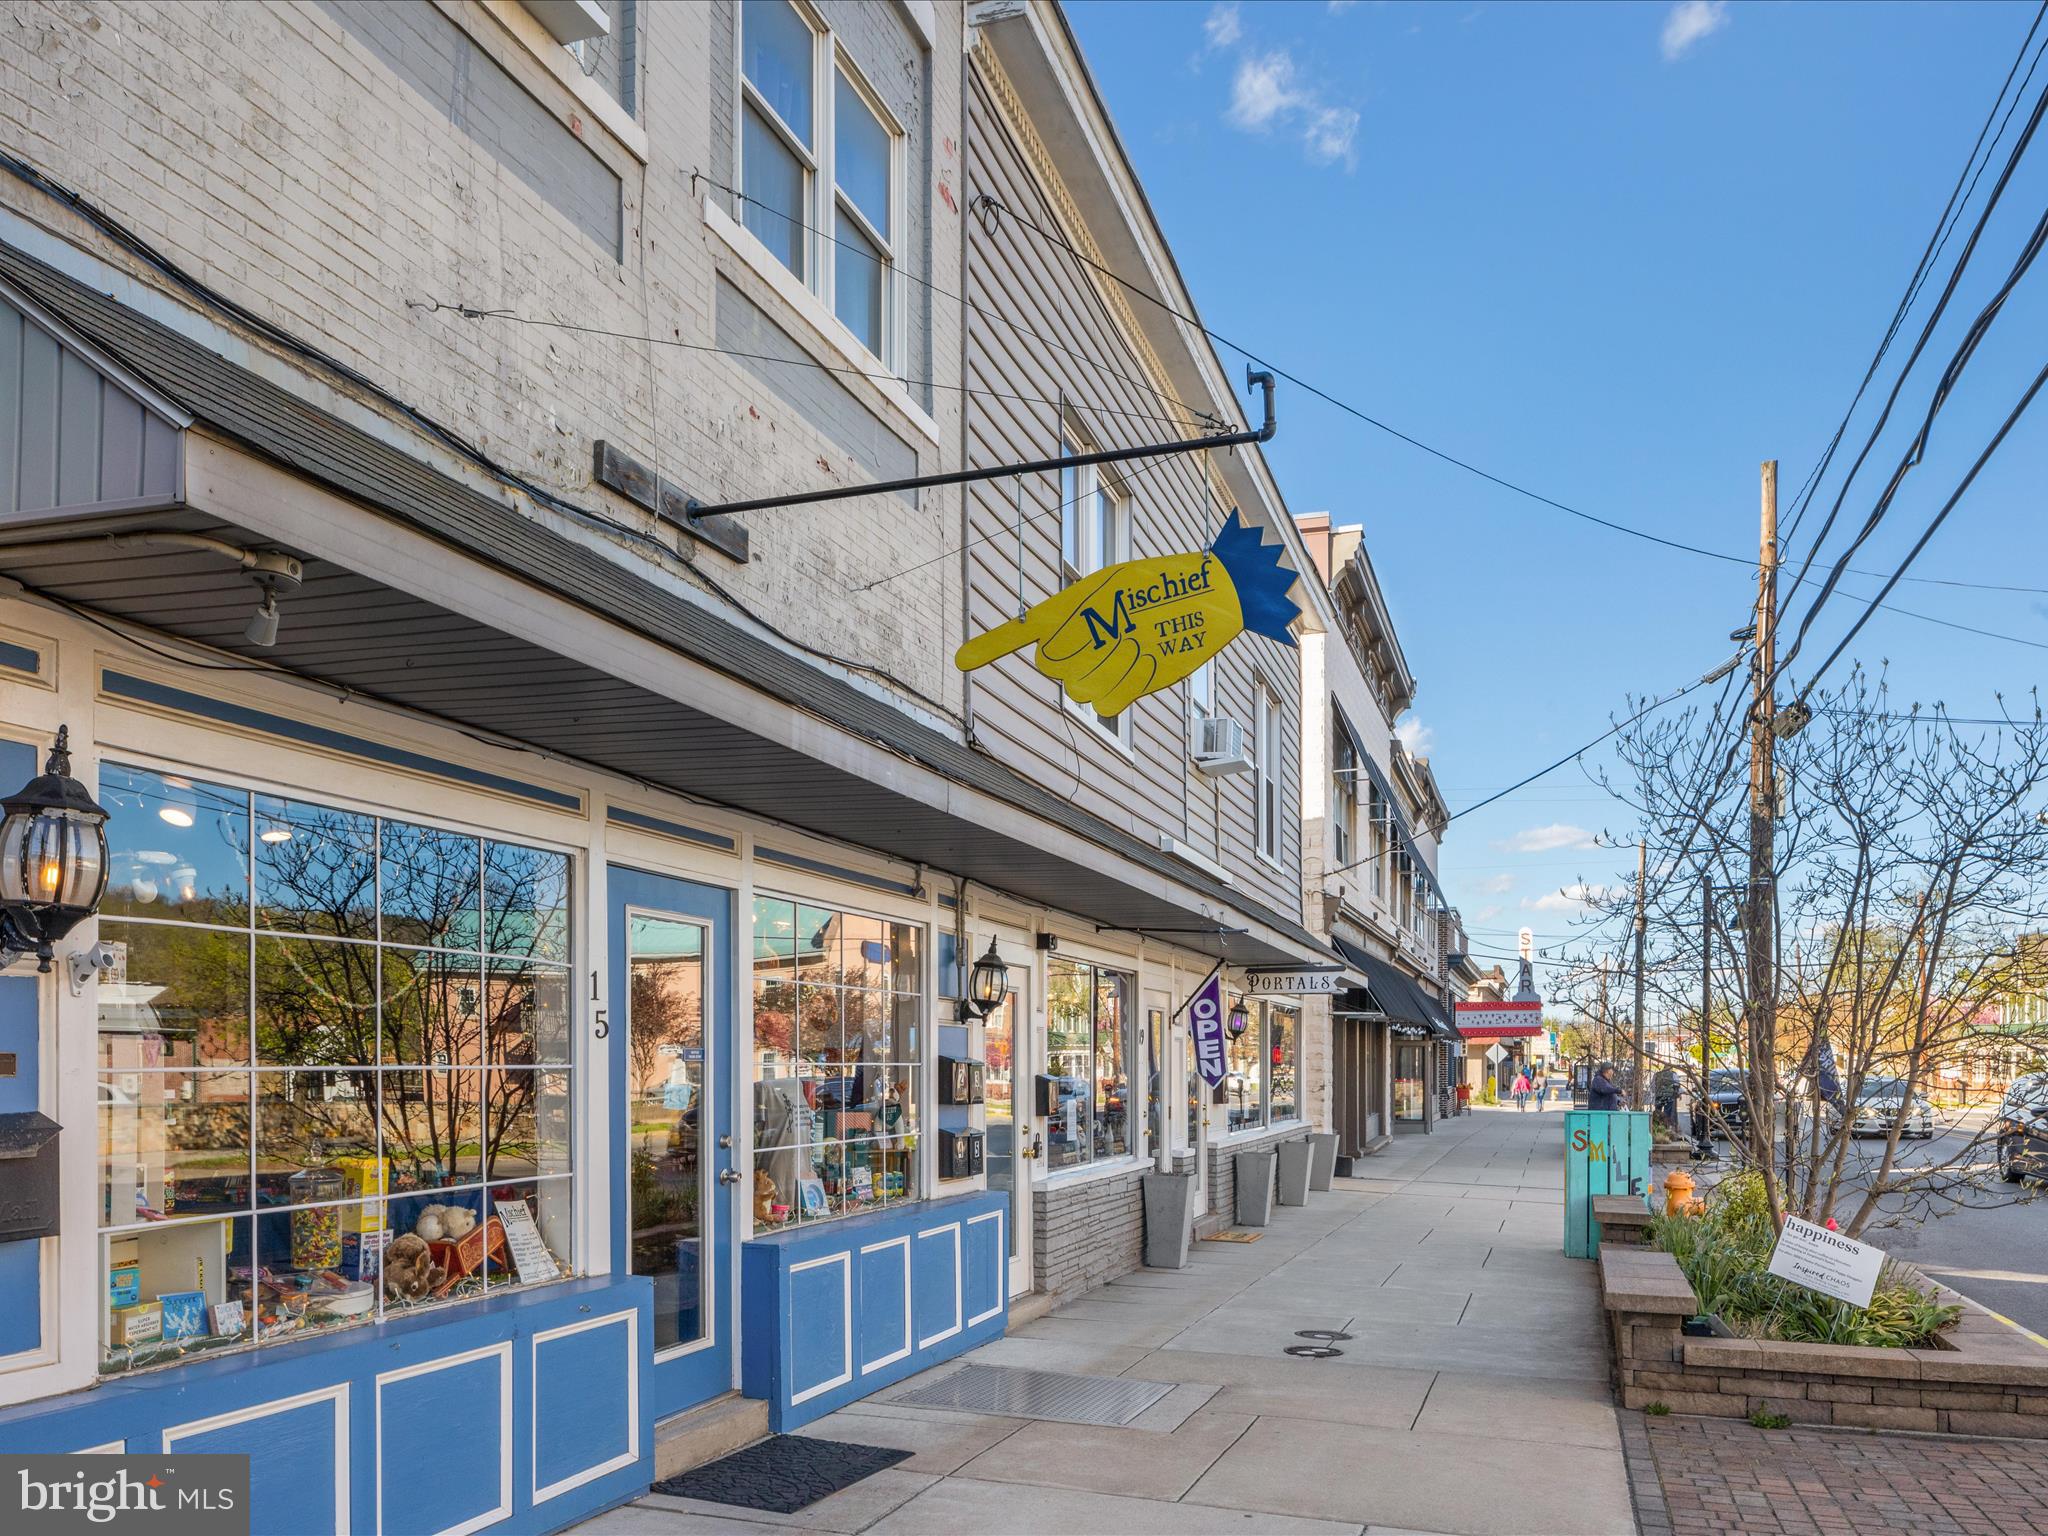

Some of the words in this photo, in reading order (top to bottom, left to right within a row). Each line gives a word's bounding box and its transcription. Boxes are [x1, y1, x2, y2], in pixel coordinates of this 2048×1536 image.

[1080, 560, 1212, 650] Mischief
[1154, 611, 1205, 638] THIS
[1158, 631, 1206, 656] WAY
[1520, 932, 1531, 994] STAR
[1246, 973, 1330, 993] PORTALS
[590, 970, 609, 1039] 15
[1193, 998, 1222, 1077] OPEN
[974, 1140, 980, 1158] 5
[1571, 1129, 1646, 1198] SMILE
[1786, 1217, 1861, 1255] happiness
[1793, 1262, 1826, 1280] Inspired
[1825, 1274, 1851, 1289] CHAOS
